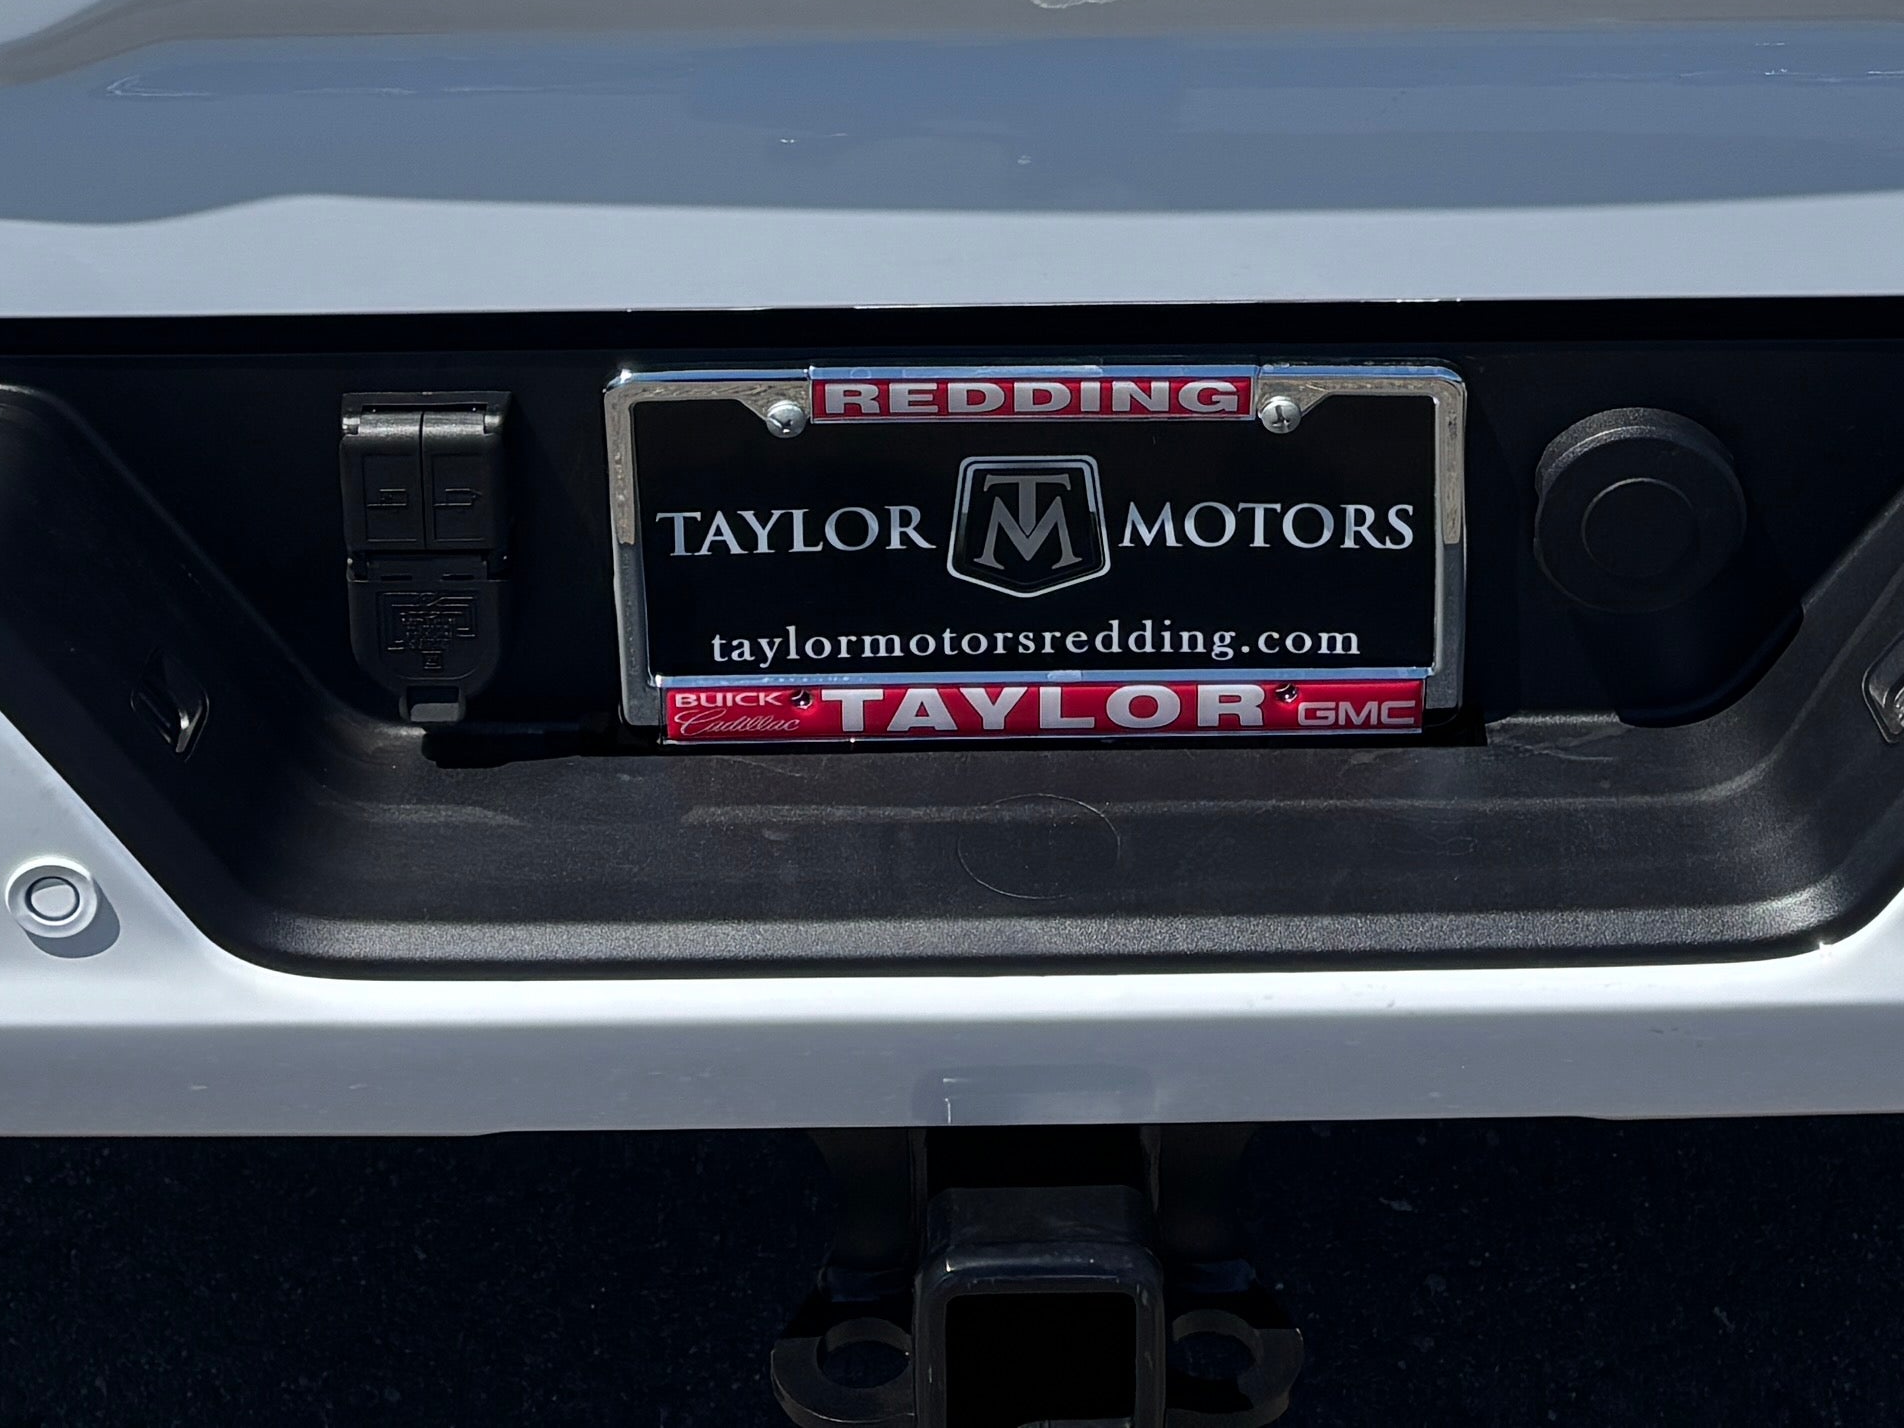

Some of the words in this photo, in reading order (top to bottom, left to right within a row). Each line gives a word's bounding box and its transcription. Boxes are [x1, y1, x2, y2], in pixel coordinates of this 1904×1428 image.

[824, 380, 1239, 414] REDDING
[656, 505, 937, 556] TAYLOR
[1118, 501, 1414, 550] MOTORS
[711, 619, 1361, 668] taylormotorsredding.com
[675, 691, 784, 708] BUICK
[821, 684, 1265, 732] TAYLOR
[1297, 700, 1417, 727] GMC
[674, 708, 800, 736] Cadillac
